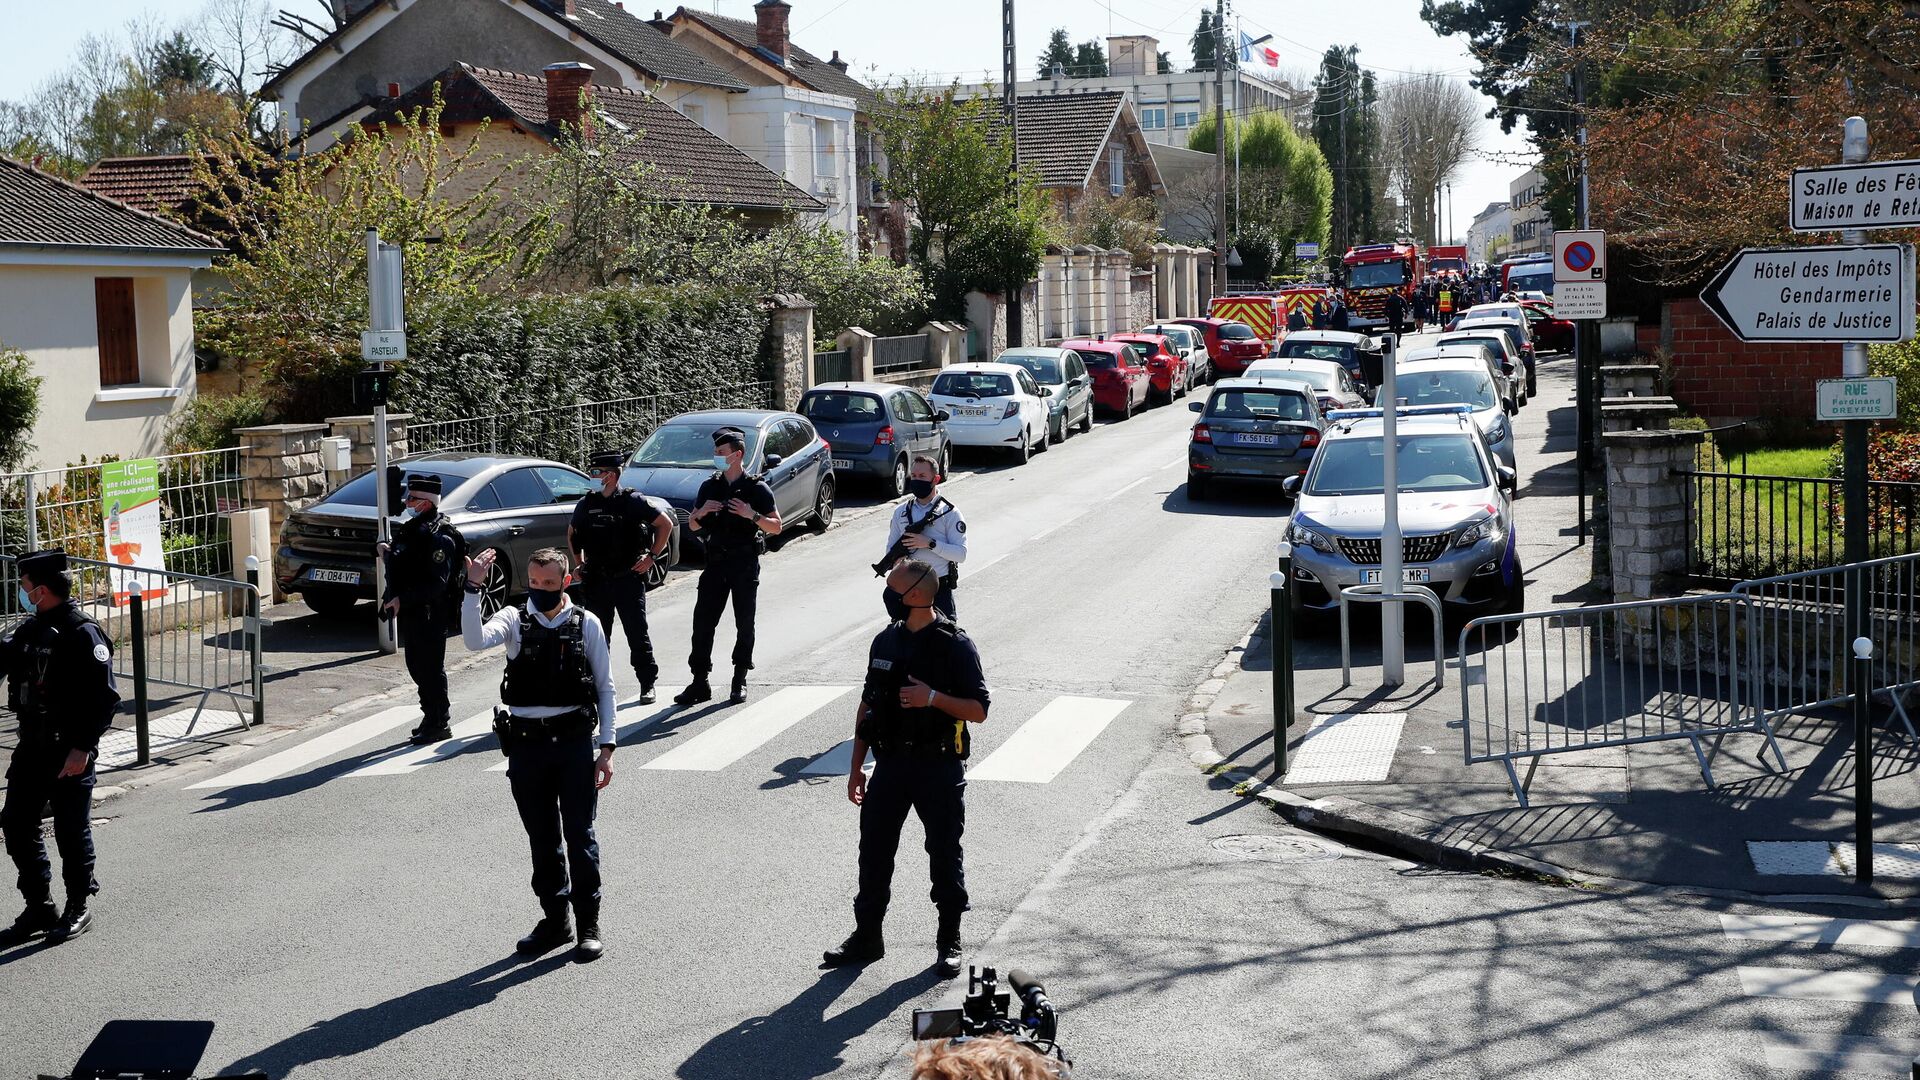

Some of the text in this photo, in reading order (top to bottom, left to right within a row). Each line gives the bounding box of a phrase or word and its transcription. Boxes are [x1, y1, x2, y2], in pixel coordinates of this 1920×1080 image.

[1803, 177, 1847, 196] Salle
[1856, 176, 1886, 193] des
[1803, 202, 1853, 220] Maison
[1864, 200, 1880, 217] de
[1754, 258, 1892, 281] Hôtel des Impôts
[1780, 285, 1892, 303] Gendarmerie
[1756, 311, 1892, 329] Palais de Justice
[371, 347, 398, 356] PASTEUR
[1844, 383, 1868, 396] RUE
[1832, 406, 1881, 414] DREYFUS
[123, 463, 138, 476] ICI
[106, 476, 155, 489] une réalisation
[874, 660, 890, 669] POLICE
